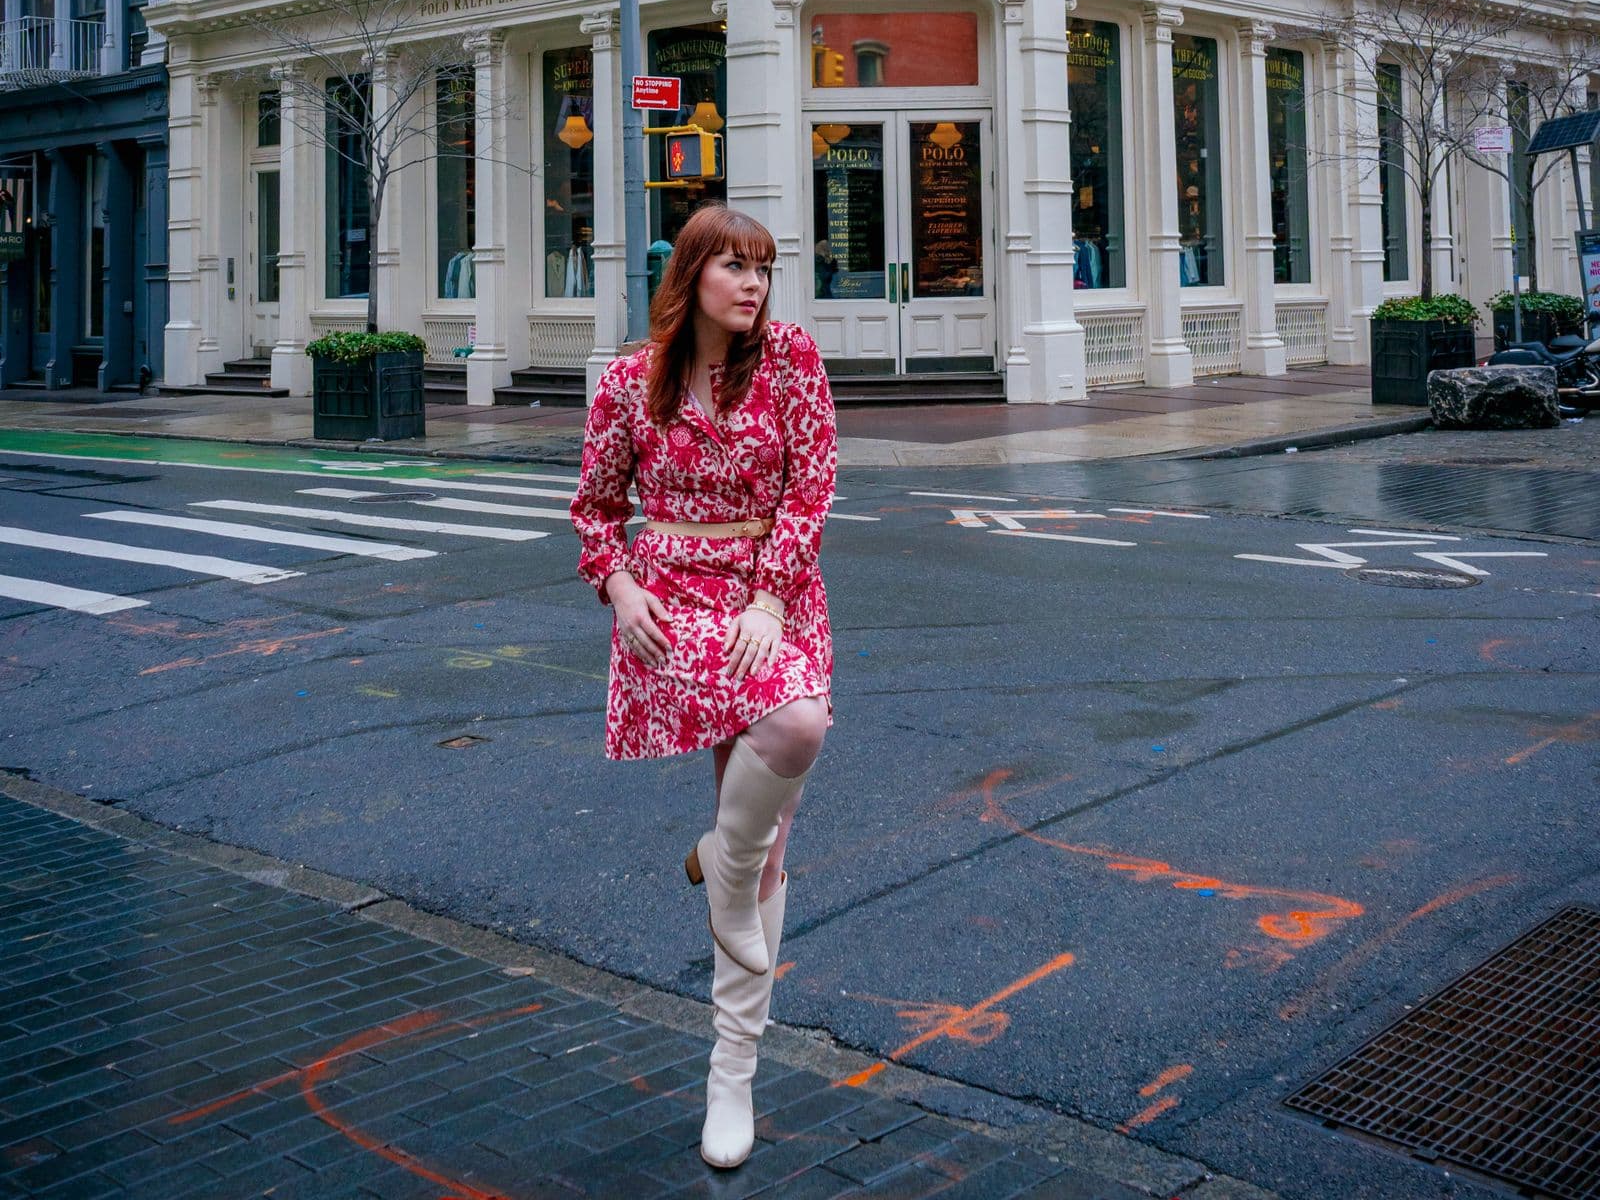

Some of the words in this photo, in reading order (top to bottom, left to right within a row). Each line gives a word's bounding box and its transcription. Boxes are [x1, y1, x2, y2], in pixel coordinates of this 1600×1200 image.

[420, 1, 449, 17] POLO
[562, 79, 592, 92] KNITWE
[636, 87, 659, 95] Anytime
[827, 148, 868, 161] POLO
[922, 147, 964, 160] POLO
